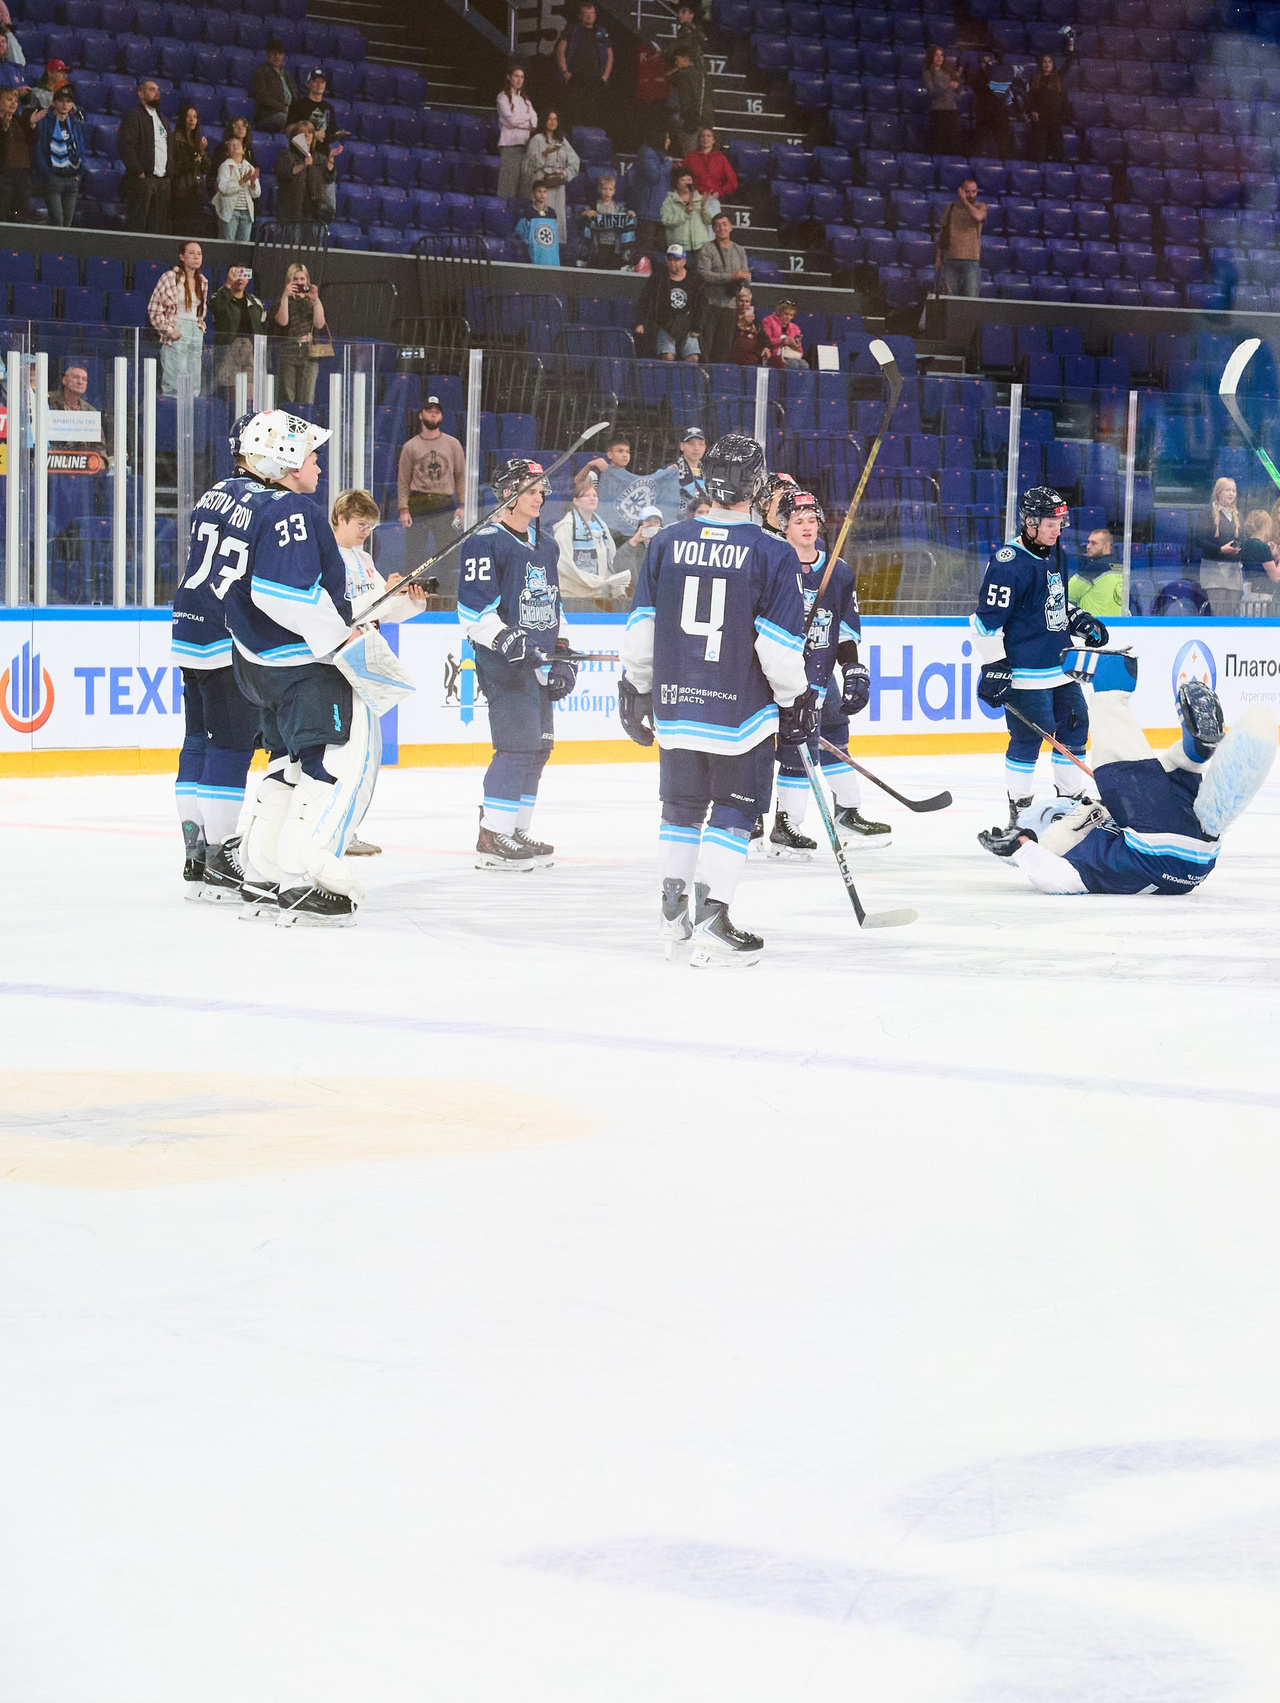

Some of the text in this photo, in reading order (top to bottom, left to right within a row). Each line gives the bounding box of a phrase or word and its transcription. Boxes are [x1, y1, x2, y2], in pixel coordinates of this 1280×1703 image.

[709, 60, 725, 74] 17
[747, 99, 763, 114] 16
[735, 211, 750, 227] 13
[789, 256, 804, 272] 12
[275, 513, 308, 548] 33
[673, 540, 749, 570] VOLKOV
[465, 557, 491, 581] 32
[986, 584, 1012, 608] 53
[680, 575, 727, 662] 4
